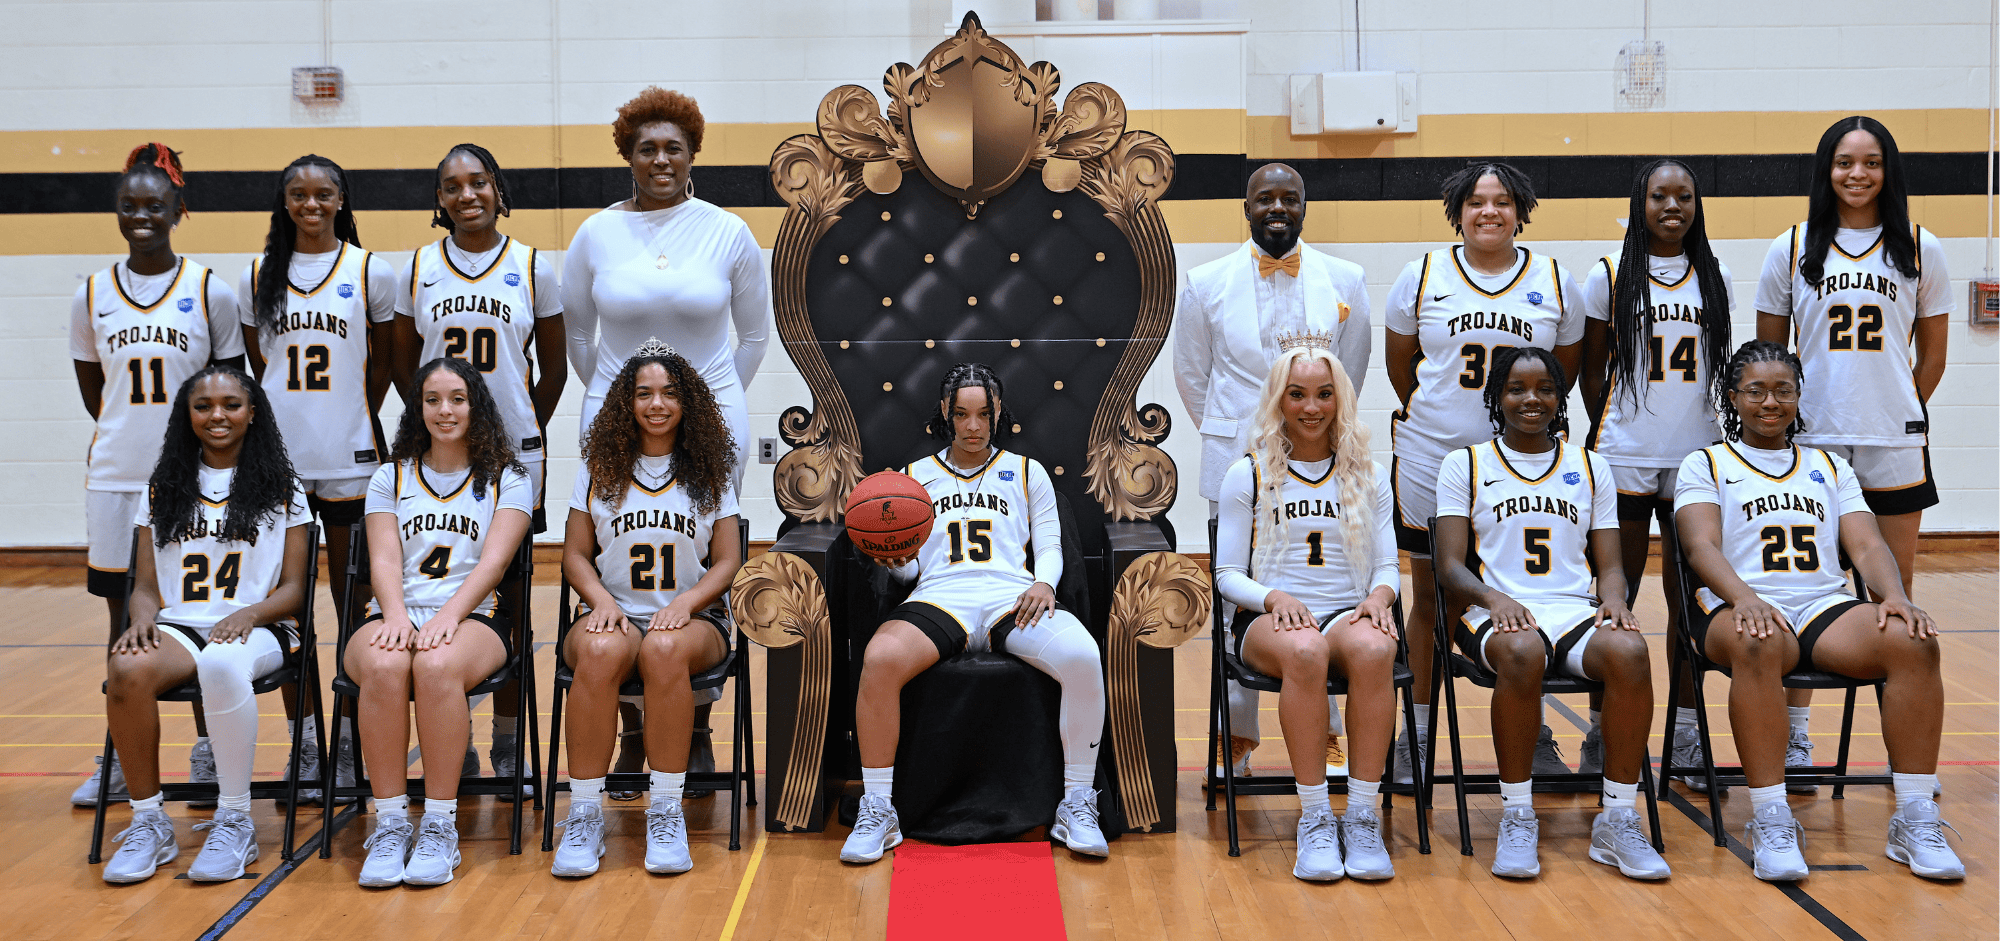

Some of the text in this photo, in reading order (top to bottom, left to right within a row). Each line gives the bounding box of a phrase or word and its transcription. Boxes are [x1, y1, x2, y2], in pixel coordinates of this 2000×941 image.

[1814, 272, 1897, 302] TROJANS
[274, 310, 347, 339] ROJANS
[431, 295, 511, 324] TROJANS
[1634, 303, 1704, 333] TROJAN
[107, 325, 188, 354] TROJANS
[1447, 311, 1533, 343] TROJANS
[1828, 303, 1885, 352] 22
[443, 326, 498, 374] 20
[1648, 335, 1698, 383] 14
[127, 356, 168, 405] 11
[286, 343, 331, 392] 12
[932, 492, 1009, 520] TROJANS
[1492, 495, 1578, 525] TROJANS
[1742, 492, 1825, 522] TROJANS
[402, 513, 480, 542] TROJANS
[611, 509, 697, 540] TROJANS
[861, 533, 920, 552] SPALDING
[946, 519, 993, 565] 15
[1306, 530, 1325, 567] 1
[1523, 527, 1552, 577] 5
[1760, 524, 1821, 573] 25
[181, 551, 243, 604] 24
[418, 544, 453, 580] 4
[629, 542, 677, 592] 21
